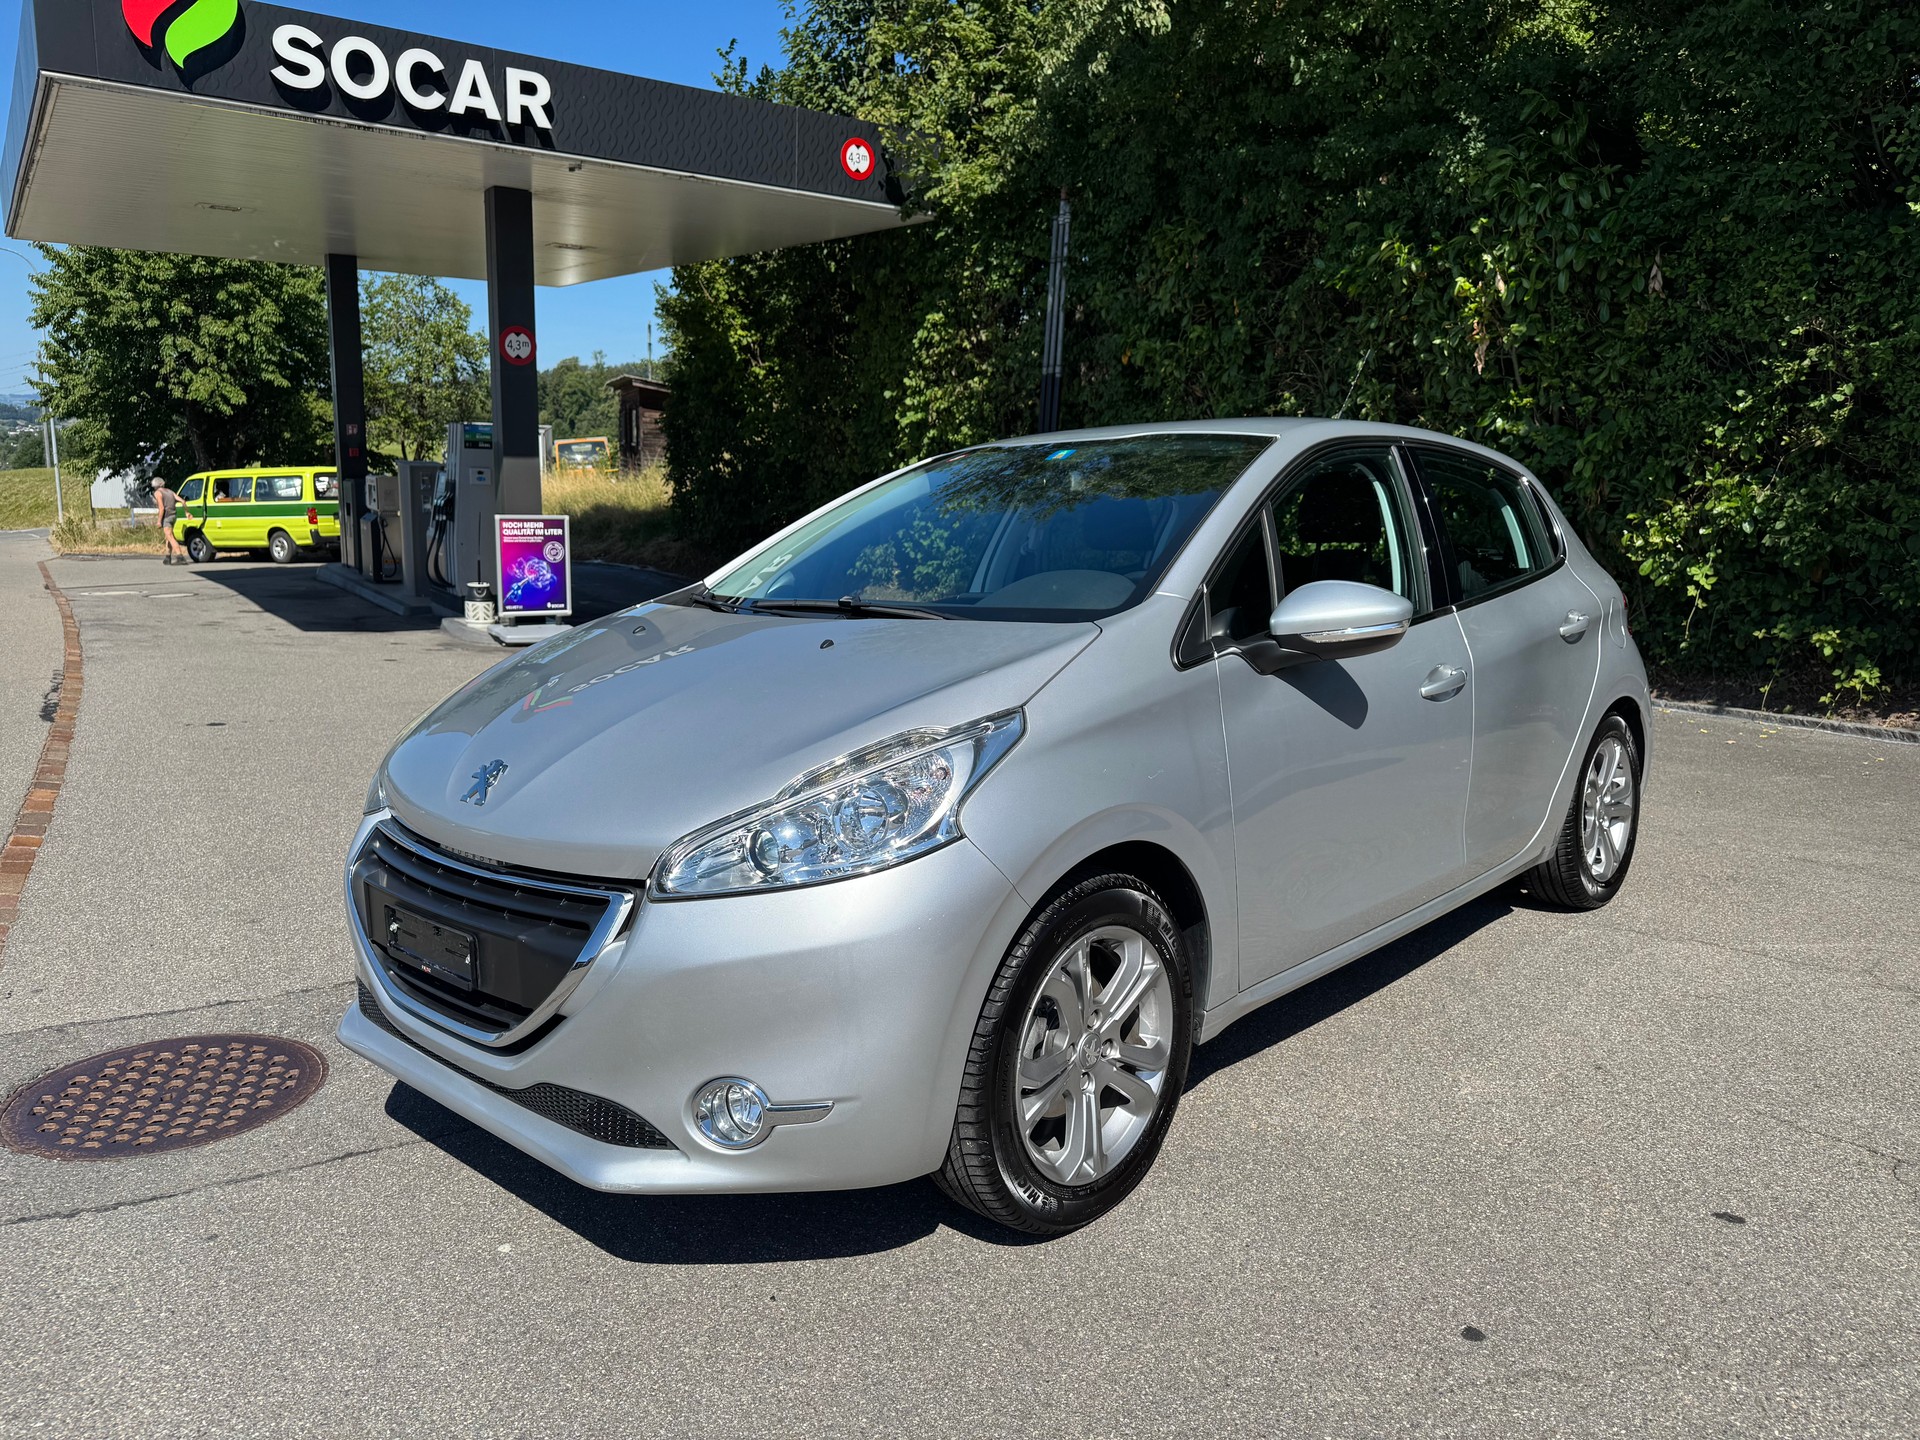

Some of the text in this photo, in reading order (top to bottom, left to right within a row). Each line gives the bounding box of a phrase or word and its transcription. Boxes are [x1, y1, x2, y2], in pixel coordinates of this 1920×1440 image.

[270, 24, 552, 130] SOCAR
[848, 152, 868, 167] 4,3m
[507, 340, 530, 352] 4,3m
[502, 528, 534, 536] QUALITÄT
